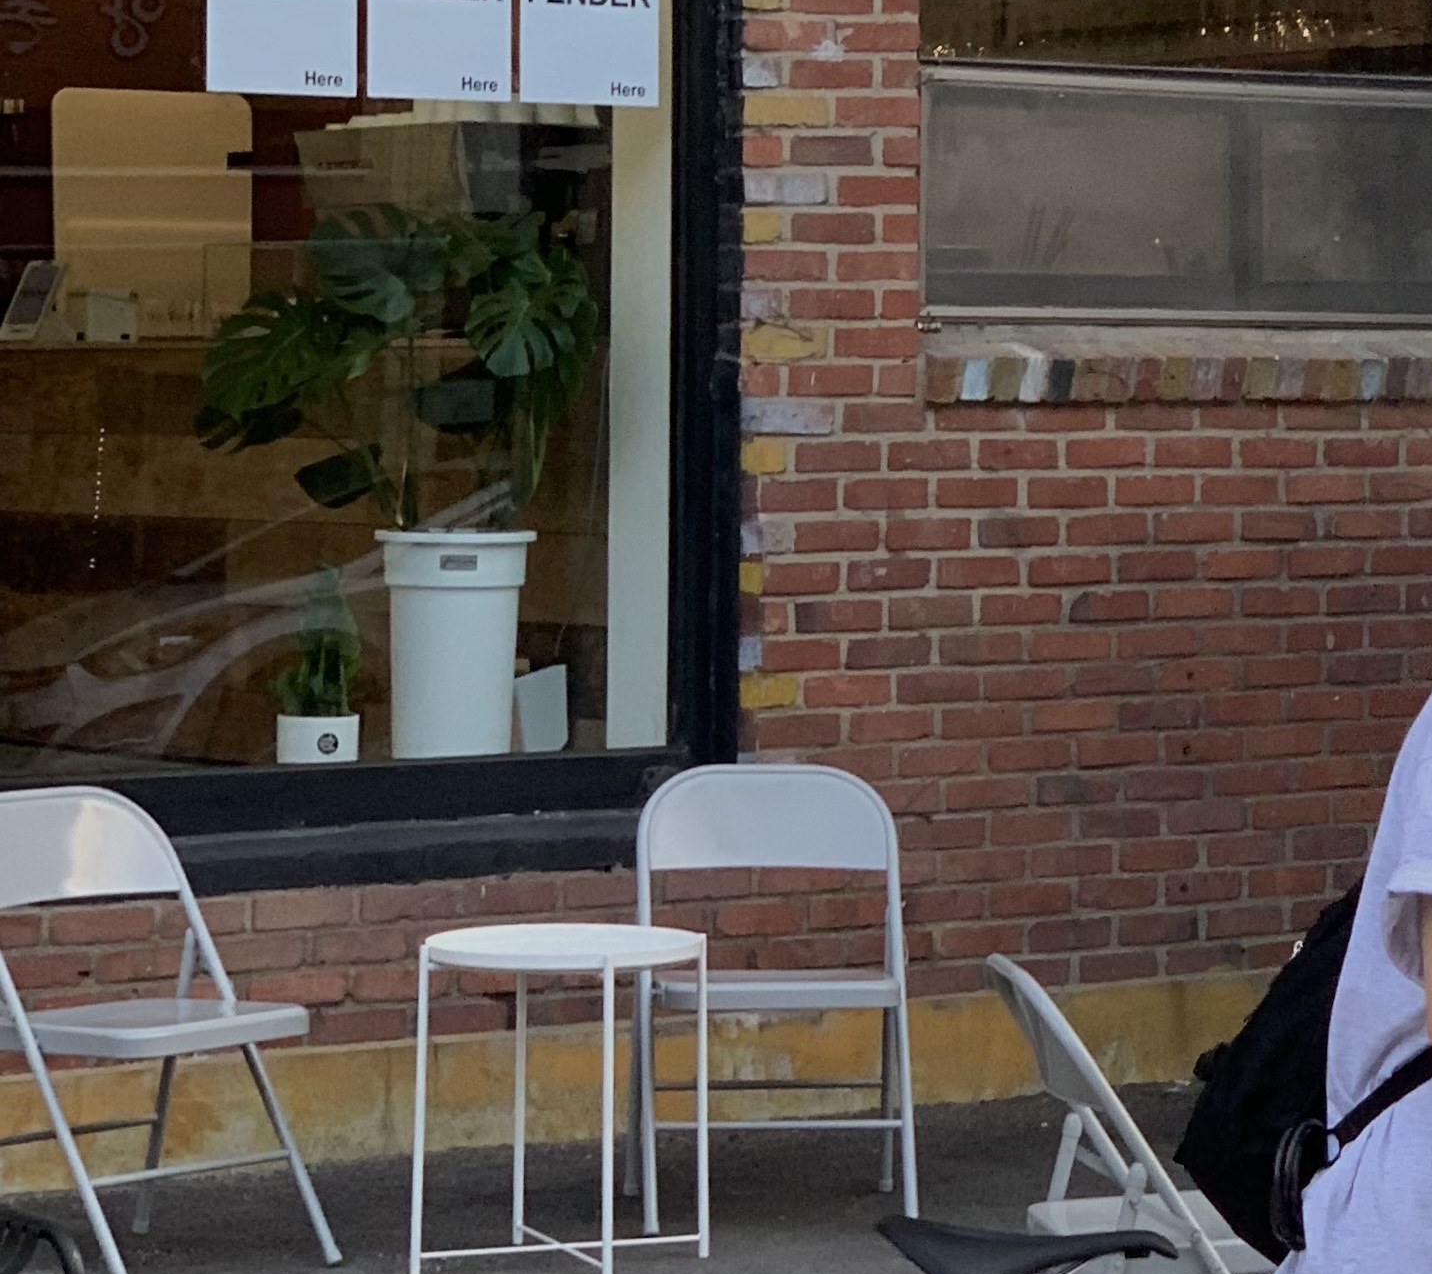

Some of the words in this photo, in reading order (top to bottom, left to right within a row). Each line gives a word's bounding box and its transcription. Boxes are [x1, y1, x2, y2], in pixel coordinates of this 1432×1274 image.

[304, 70, 343, 88] Here
[461, 76, 498, 93] Here
[610, 81, 646, 98] Here
